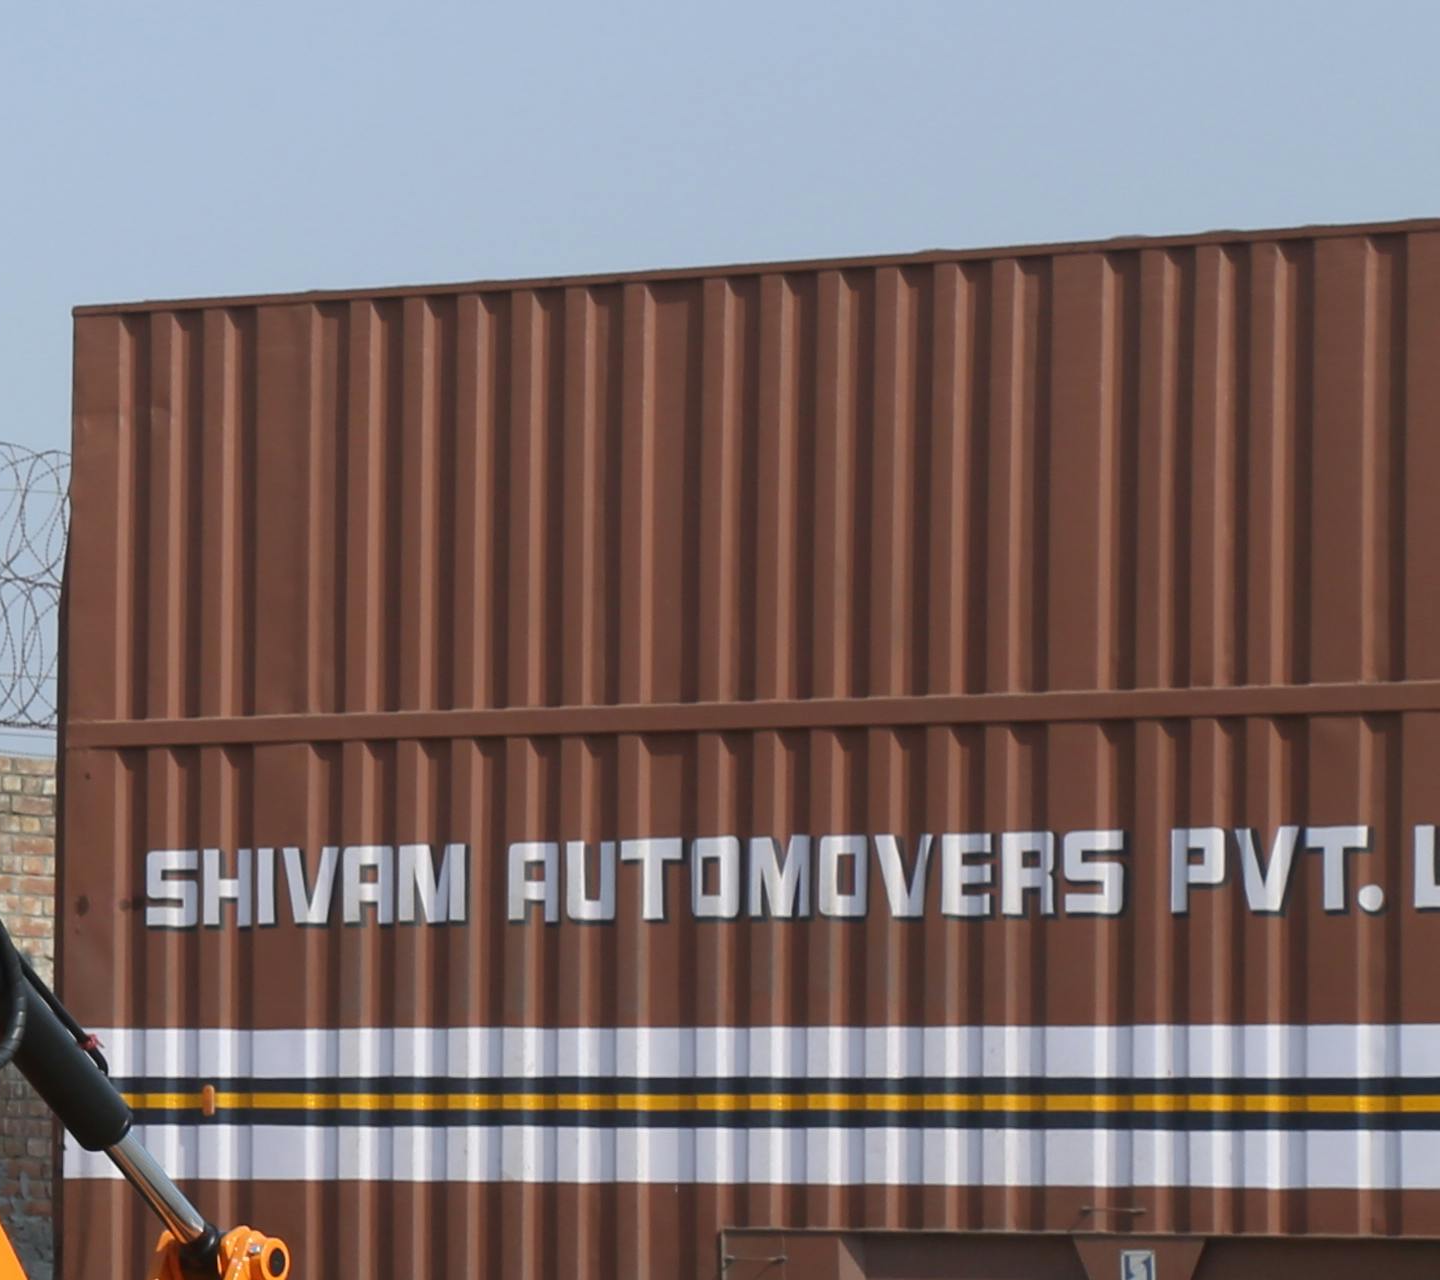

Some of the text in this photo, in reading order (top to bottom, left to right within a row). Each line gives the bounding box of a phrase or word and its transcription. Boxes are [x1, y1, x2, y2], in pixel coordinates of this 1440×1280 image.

[145, 842, 467, 929] SHIVAM
[507, 828, 1125, 923] AUTOMOVERS
[1170, 823, 1385, 915] PVT.
